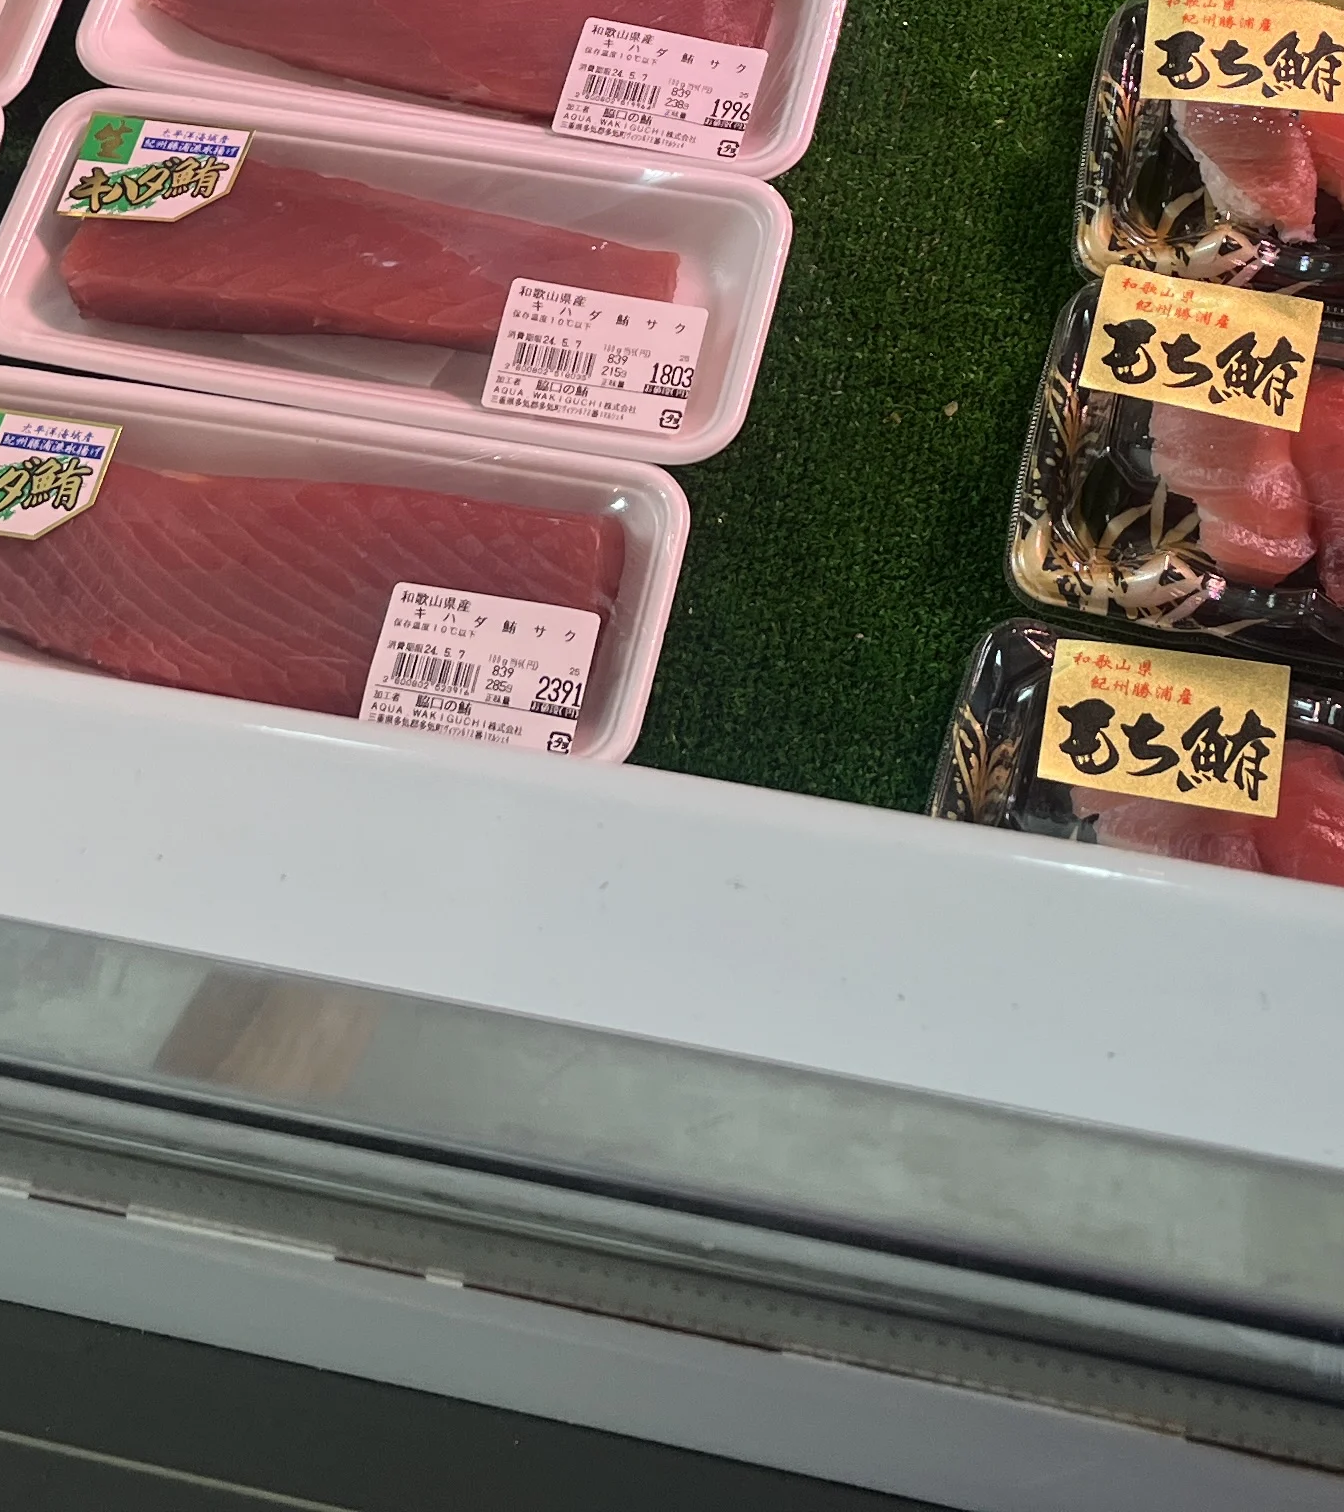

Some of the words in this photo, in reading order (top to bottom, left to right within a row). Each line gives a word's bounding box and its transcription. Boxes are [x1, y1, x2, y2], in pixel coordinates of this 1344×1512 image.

[590, 23, 654, 46] 和歌山県産
[602, 37, 747, 73] キハダ鮪サク
[709, 98, 752, 123] 1996
[94, 120, 133, 158] 生
[68, 156, 229, 212] キハダ鮪
[517, 284, 587, 307] 和歌山県産
[1119, 276, 1196, 303] 和歌山県
[530, 298, 686, 336] キハダ鮪サク
[649, 362, 694, 389] 1803
[399, 588, 472, 614] 和歌山県産
[413, 604, 576, 645] キハダ鮪サク
[1071, 650, 1153, 677] 和歌山県
[534, 675, 585, 707] 2391
